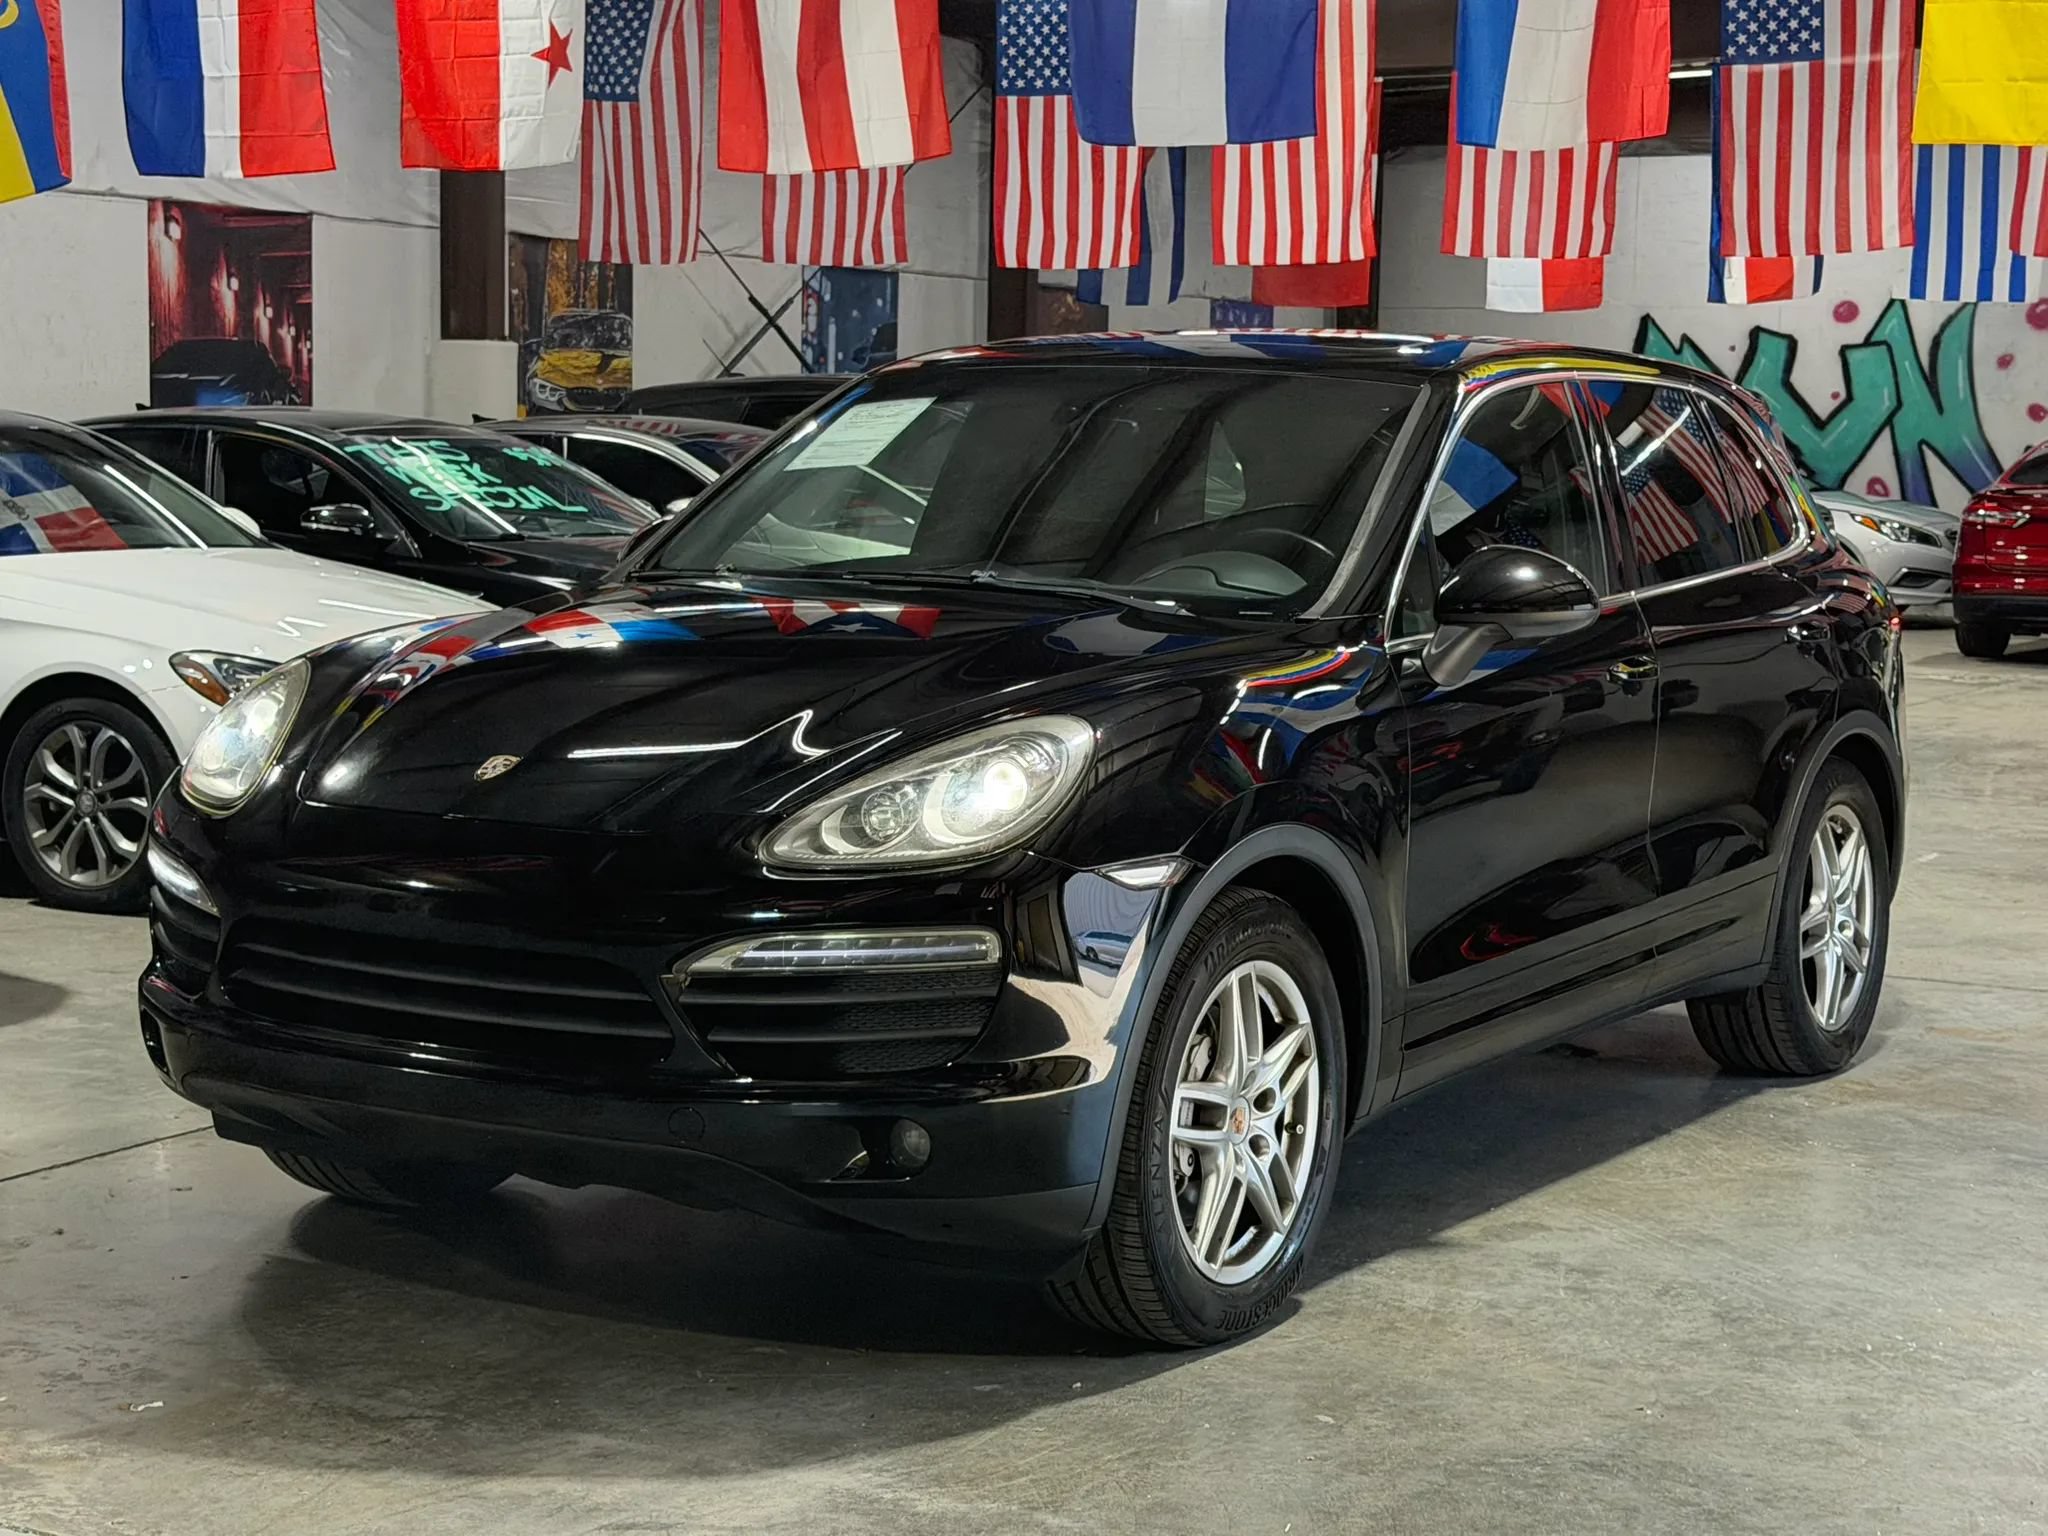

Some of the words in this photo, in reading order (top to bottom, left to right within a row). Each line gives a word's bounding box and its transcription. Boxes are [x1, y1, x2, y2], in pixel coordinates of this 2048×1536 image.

[345, 440, 470, 465] THIS
[384, 461, 503, 485] WEEK
[409, 485, 588, 512] SPECIAL
